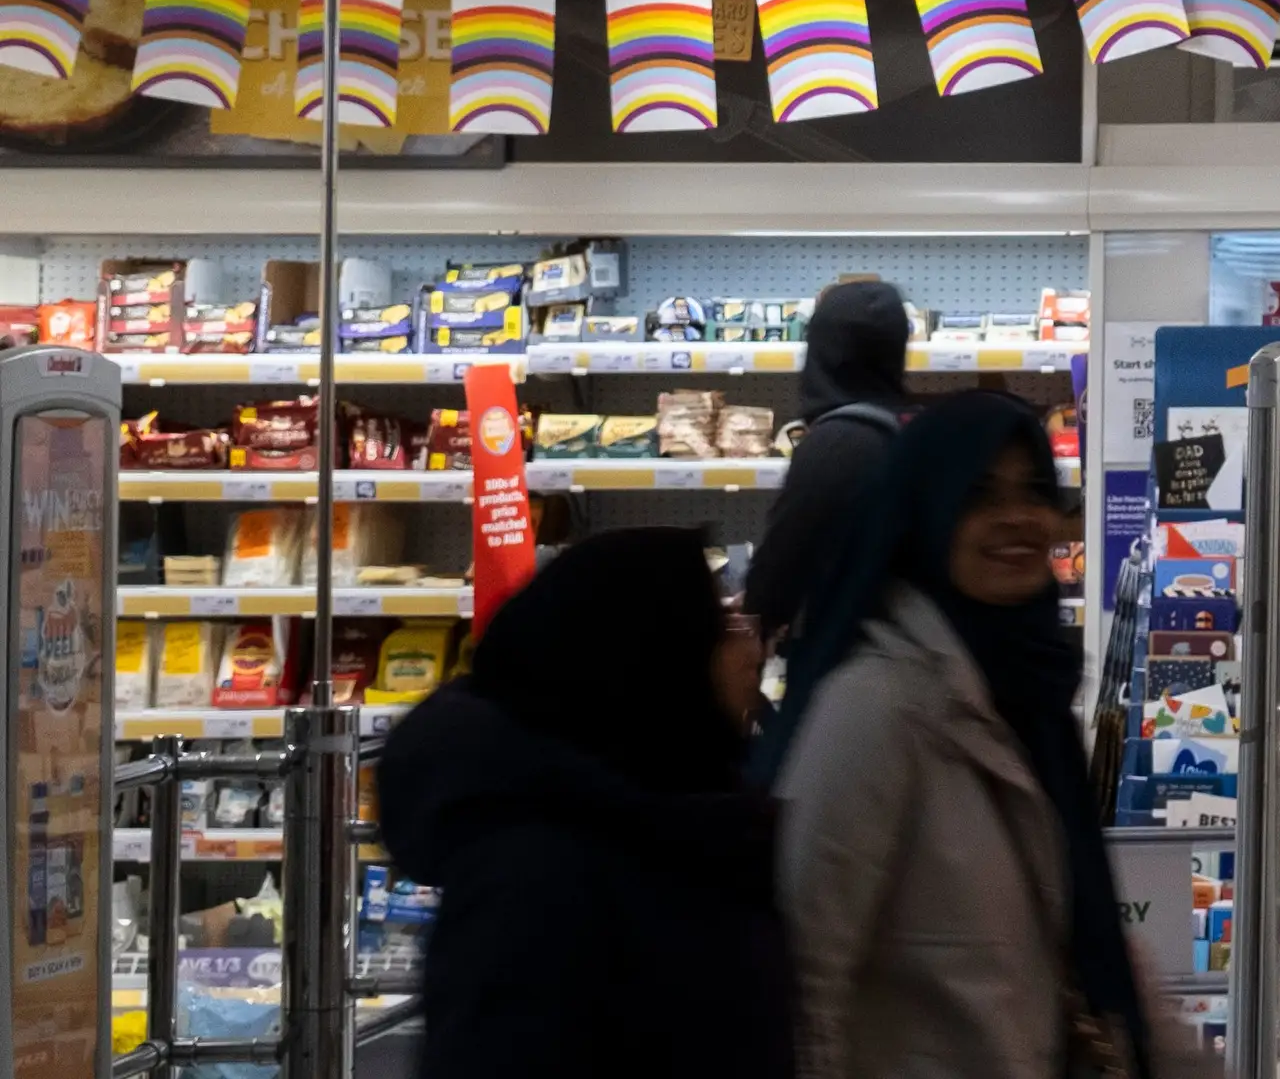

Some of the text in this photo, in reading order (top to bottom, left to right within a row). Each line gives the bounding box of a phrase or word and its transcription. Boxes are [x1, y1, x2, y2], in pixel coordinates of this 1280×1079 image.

[1114, 359, 1141, 370] Start
[1175, 445, 1204, 460] DAD
[487, 536, 502, 548] to
[180, 957, 210, 973] AVE
